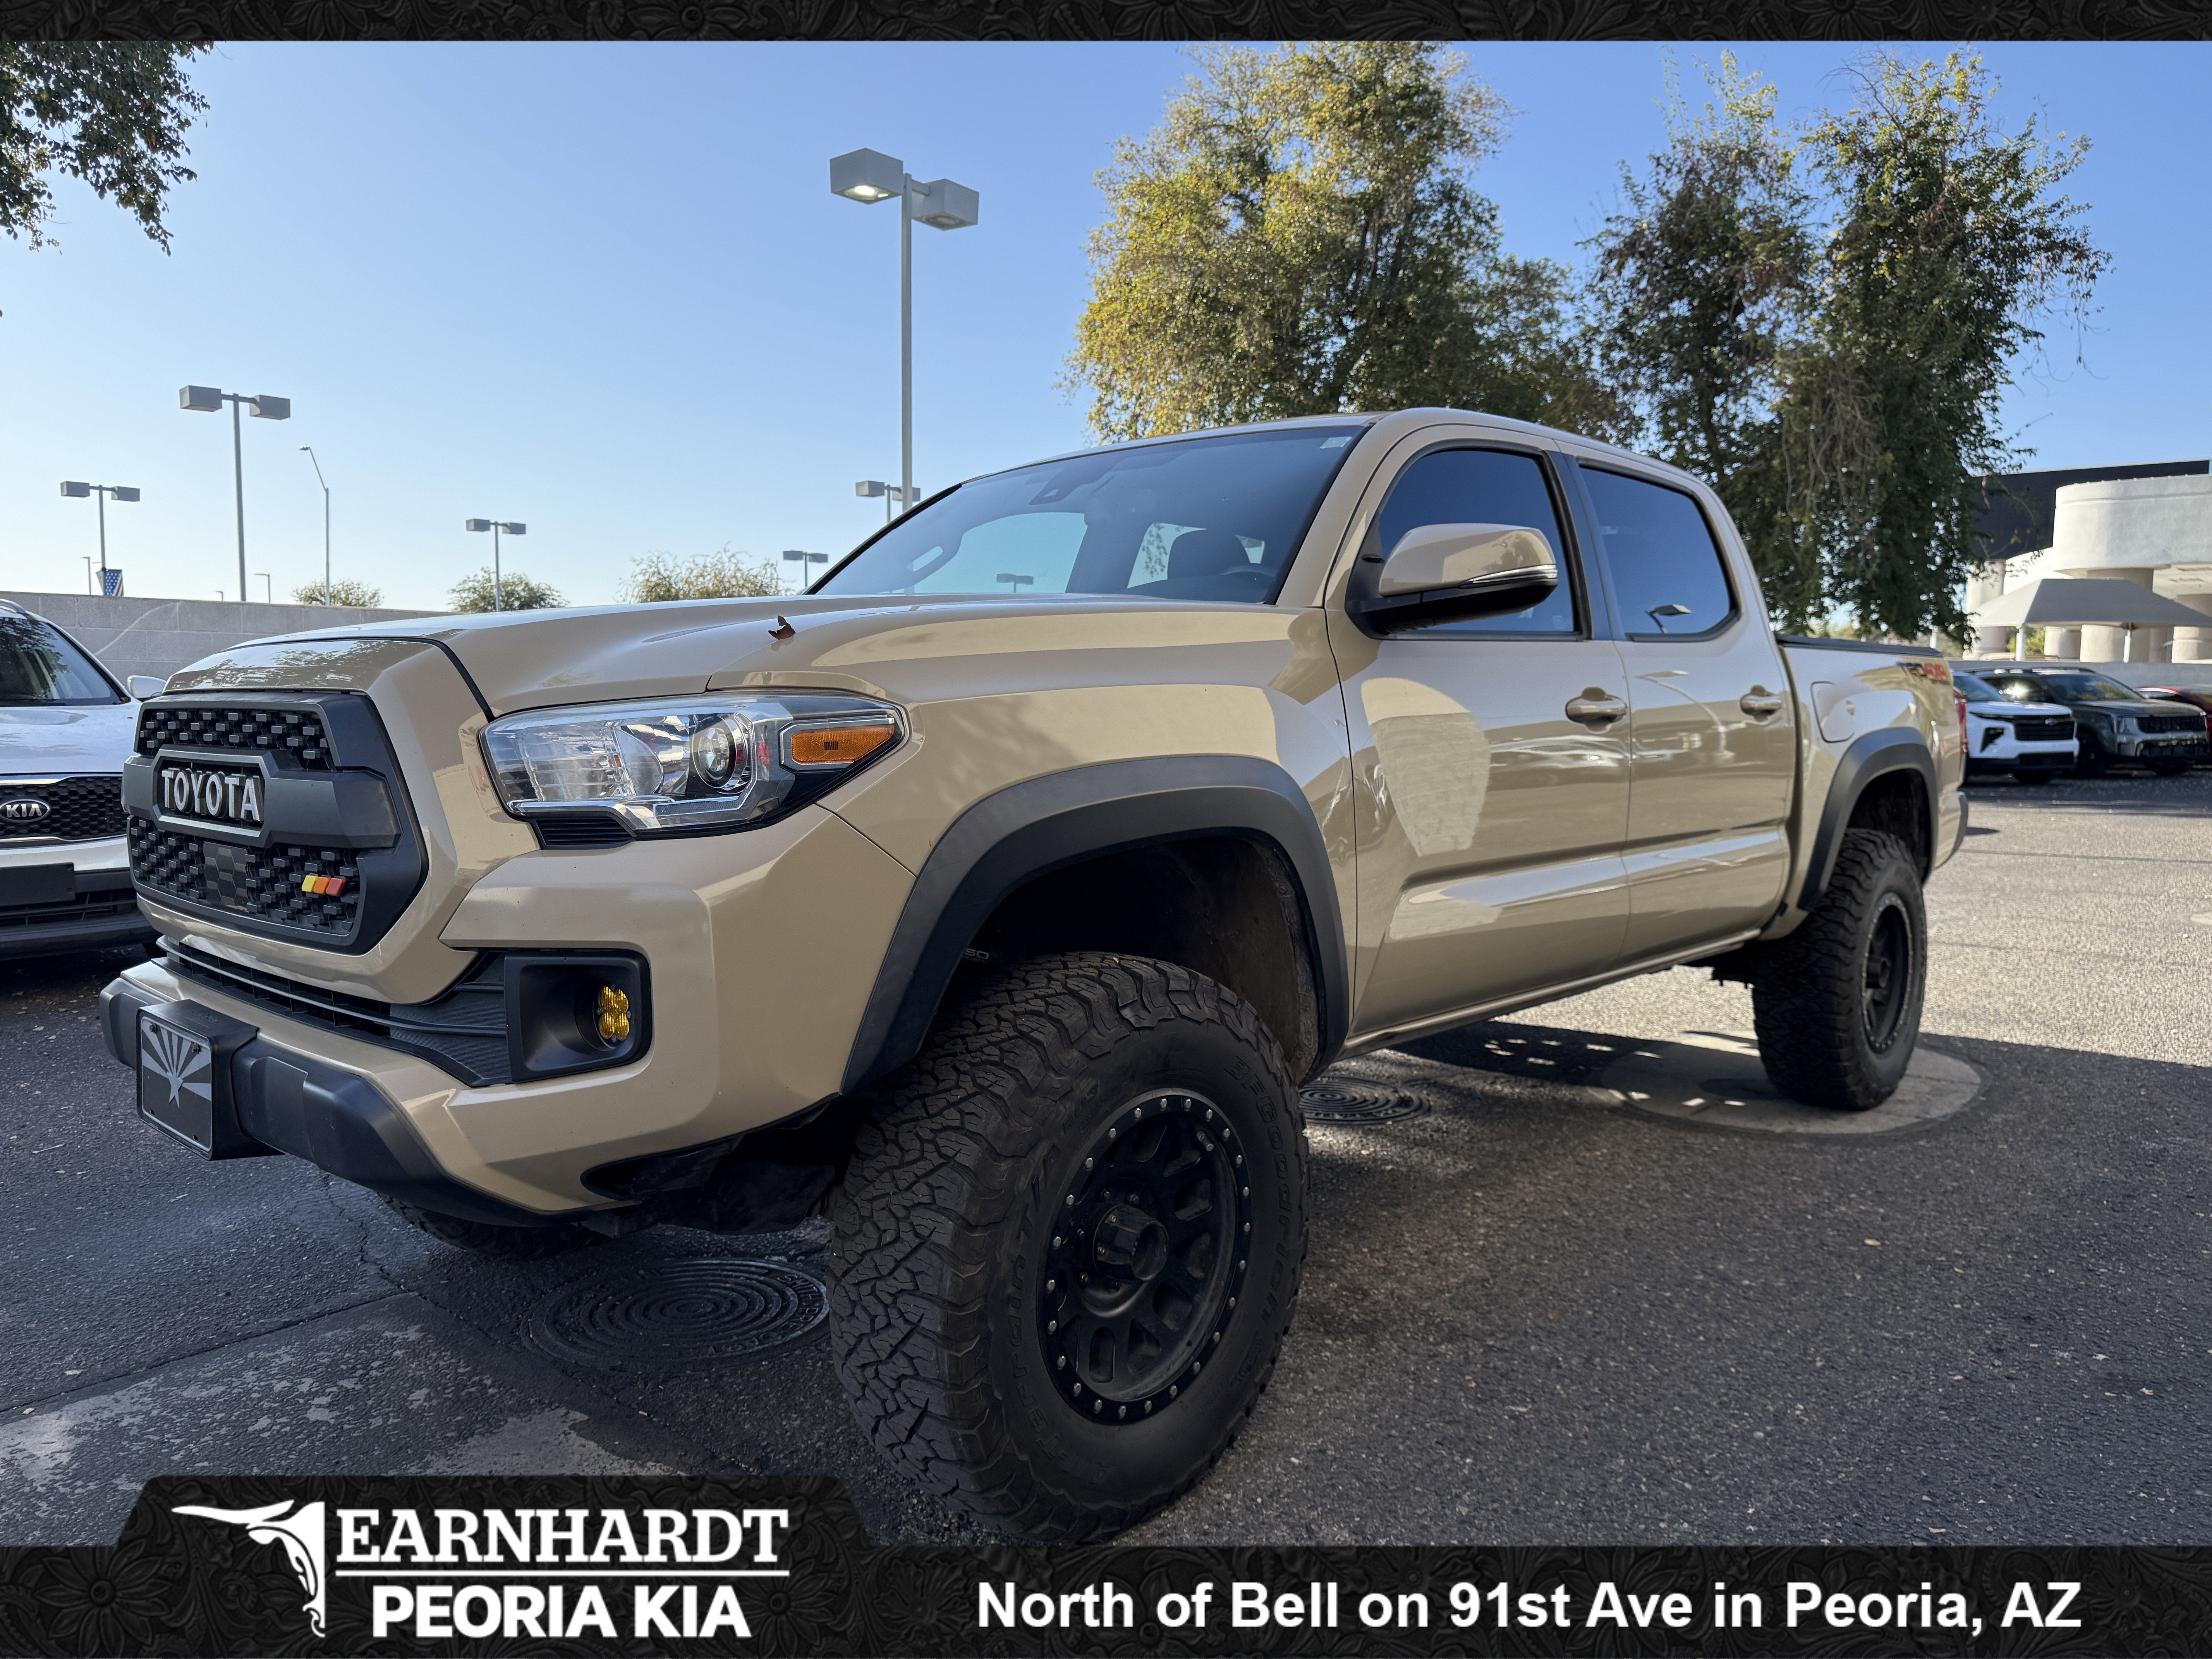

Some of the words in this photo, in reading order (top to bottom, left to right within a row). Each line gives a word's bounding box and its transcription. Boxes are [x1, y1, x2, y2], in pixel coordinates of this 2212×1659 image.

[6, 804, 42, 817] KIA
[161, 769, 261, 822] TOYOTA
[1223, 1055, 1293, 1324] BFGoodrich
